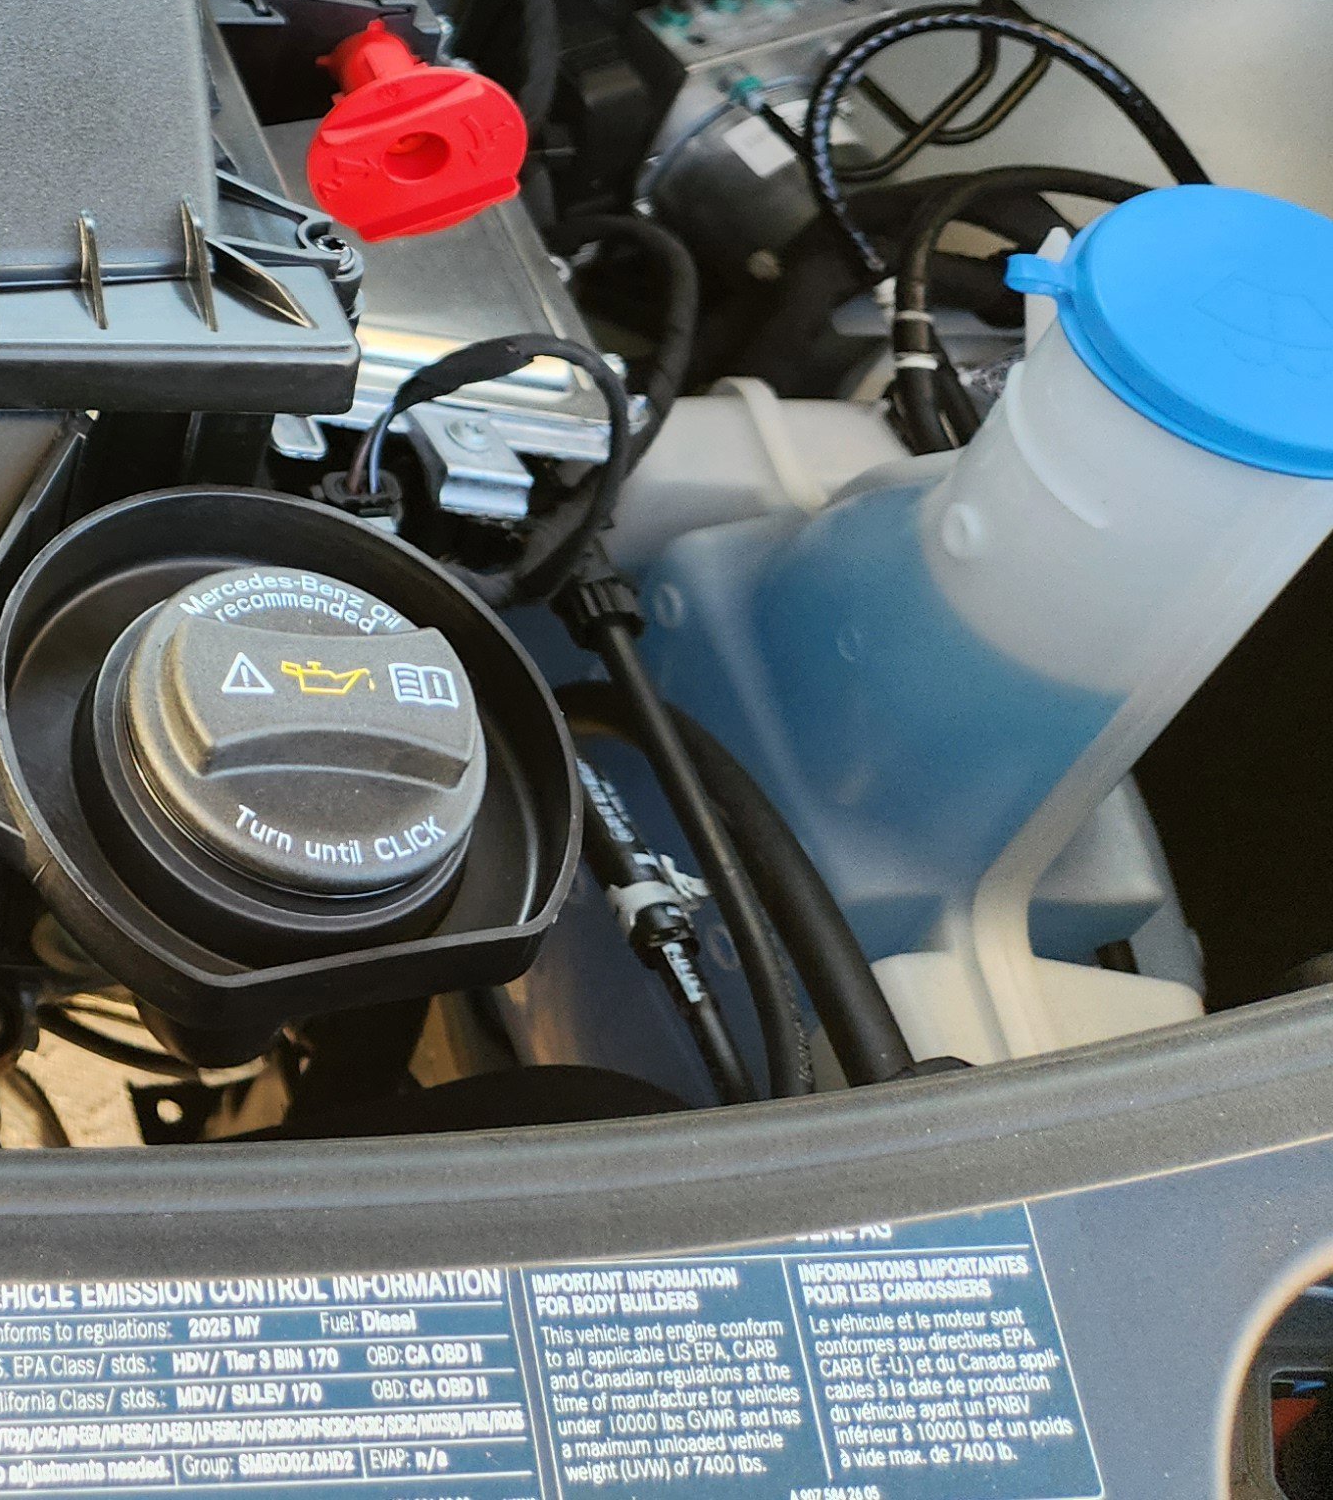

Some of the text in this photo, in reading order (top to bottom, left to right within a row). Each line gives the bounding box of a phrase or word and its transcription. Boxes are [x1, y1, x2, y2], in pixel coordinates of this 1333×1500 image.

[179, 573, 402, 630] Mercedes-Benz Oil
[215, 592, 378, 634] recommended
[235, 805, 447, 864] Turn until CLICK
[532, 1268, 738, 1294] IMPORTANT INFORMATION
[798, 1255, 1029, 1283] INFORMATIONS IMPORTANTES
[81, 1282, 203, 1308] EMISSION
[208, 1279, 328, 1304] CONTROL
[333, 1269, 502, 1299] INFORMATION
[802, 1279, 991, 1307] POUR LES CARROSSIERS
[536, 1291, 699, 1316] FOR BODY BUILDERS
[56, 1321, 72, 1341] to
[77, 1320, 173, 1345] regulations:
[188, 1317, 231, 1338] 2025
[234, 1316, 261, 1336] MY
[320, 1309, 417, 1334] Fuel: Diesel
[541, 1318, 783, 1345] This vehicle and engine conform
[809, 1308, 1024, 1335] Le véhicule et le moteur sont
[367, 1343, 482, 1365] OBD: CA OBD II
[545, 1339, 777, 1369] to all applicable US EPA, CARB
[815, 1328, 1035, 1356] conformes aux directives EPA
[14, 1356, 47, 1377] EPA
[50, 1353, 104, 1378] Class/
[172, 1351, 220, 1375] HDV/
[223, 1350, 260, 1370] Tier
[259, 1349, 270, 1369] 3
[274, 1349, 303, 1369] BIN
[309, 1347, 338, 1368] 170
[550, 1363, 790, 1390] and Canadian regulations at the
[59, 1387, 114, 1413] Class/
[176, 1386, 226, 1410] MDV/
[229, 1384, 285, 1405] SULEV
[292, 1383, 322, 1403] 170
[372, 1377, 487, 1399] OBD: CA OBD II
[552, 1385, 800, 1413] time of manufacture for vehicles
[557, 1407, 801, 1436] under 10000 lbs GVWR and has
[370, 1447, 448, 1470] EVAP: n/a
[562, 1431, 783, 1458] a maximum unloaded vehicle
[9, 1459, 105, 1488] adjustments
[109, 1457, 171, 1479] needed.
[183, 1455, 234, 1480] Group:
[564, 1453, 767, 1484] weight (UVW) of 7400 lbs.
